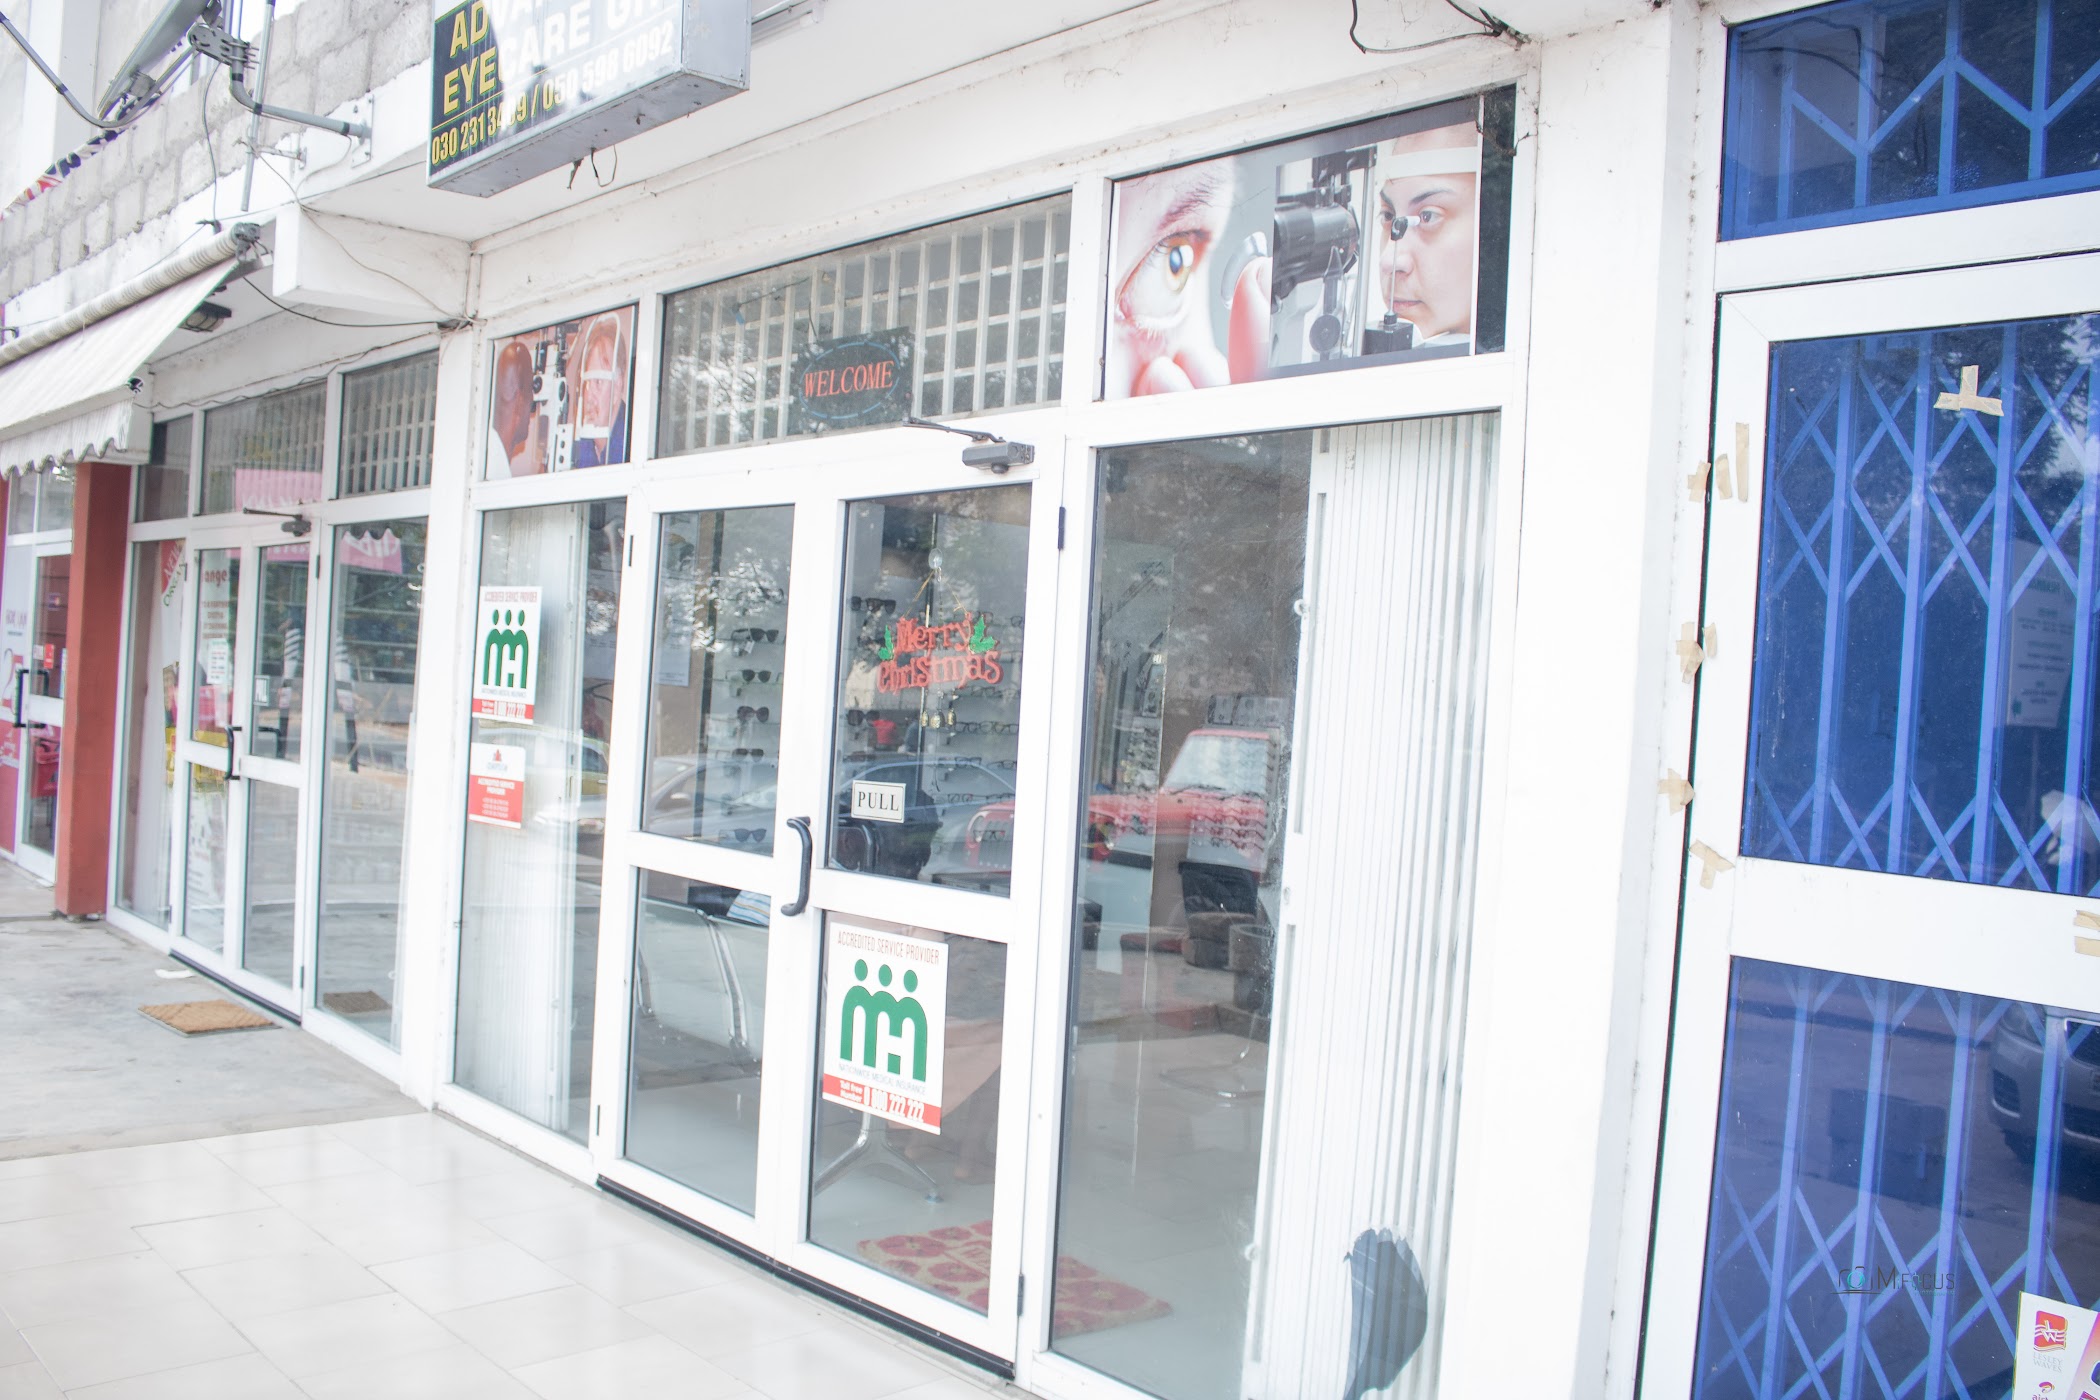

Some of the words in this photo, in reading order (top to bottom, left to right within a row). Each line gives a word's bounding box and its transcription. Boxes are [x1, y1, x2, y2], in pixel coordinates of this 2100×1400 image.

[432, 127, 458, 165] 030
[460, 115, 484, 152] 231
[543, 68, 578, 111] 050
[582, 50, 620, 93] 598
[623, 19, 674, 72] 6092
[804, 360, 895, 398] WELCOME
[895, 614, 973, 655] Merry
[858, 791, 899, 812] PULL
[837, 931, 876, 952] ACCREDITED
[877, 938, 904, 958] SERVICE
[905, 944, 940, 965] PROVIDER
[863, 1086, 871, 1107] 0
[871, 1088, 888, 1111] 800
[889, 1093, 906, 1117] 222
[907, 1099, 925, 1123] 222
[2033, 1352, 2063, 1366] LESLEY
[2033, 1358, 2062, 1373] WAVES
